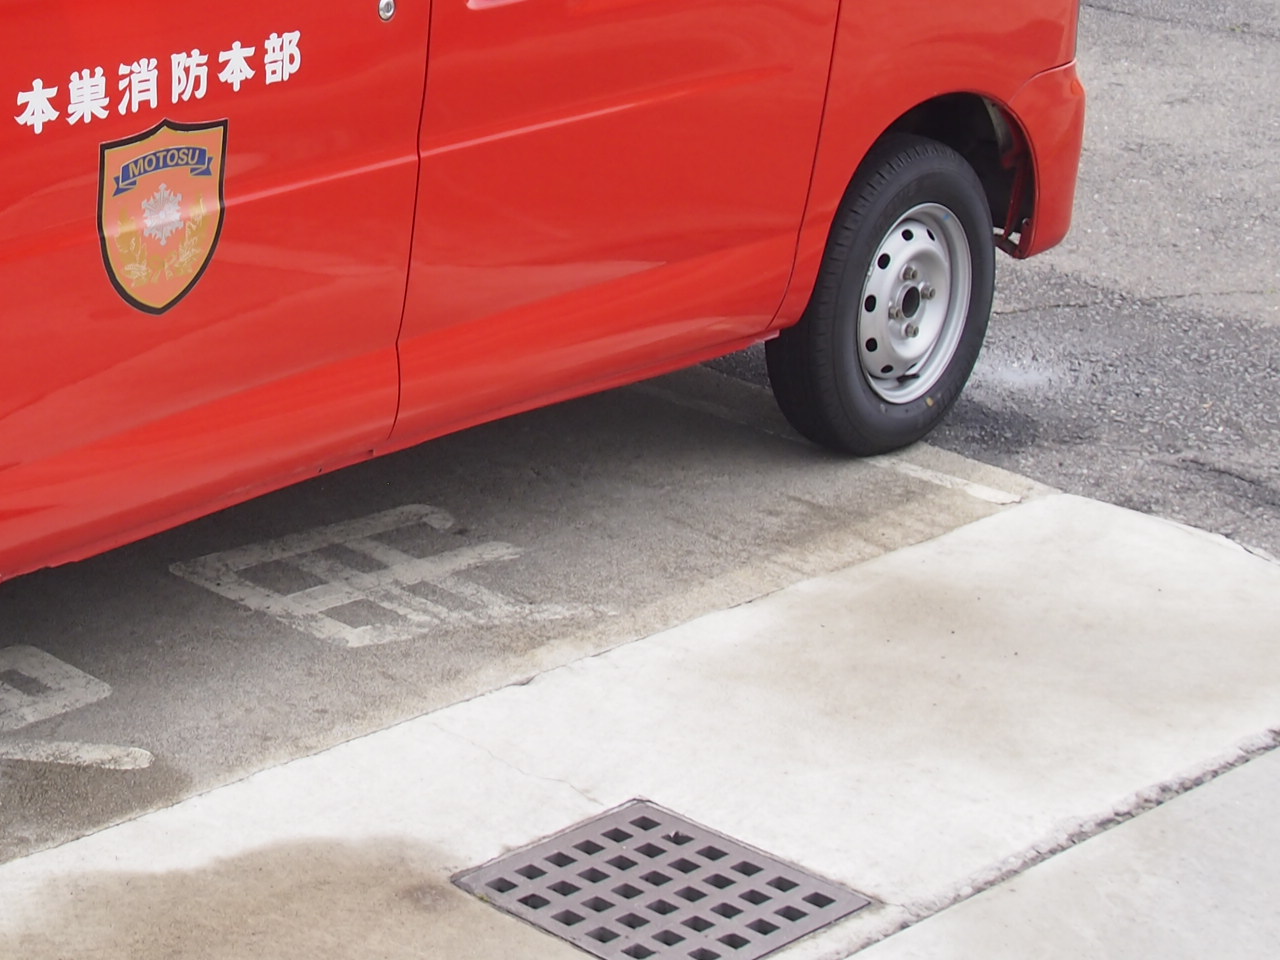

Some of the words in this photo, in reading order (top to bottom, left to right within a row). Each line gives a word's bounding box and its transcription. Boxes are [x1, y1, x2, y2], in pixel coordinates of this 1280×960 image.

[14, 30, 301, 135] 本巣消防本部
[128, 149, 200, 179] MOTOSU
